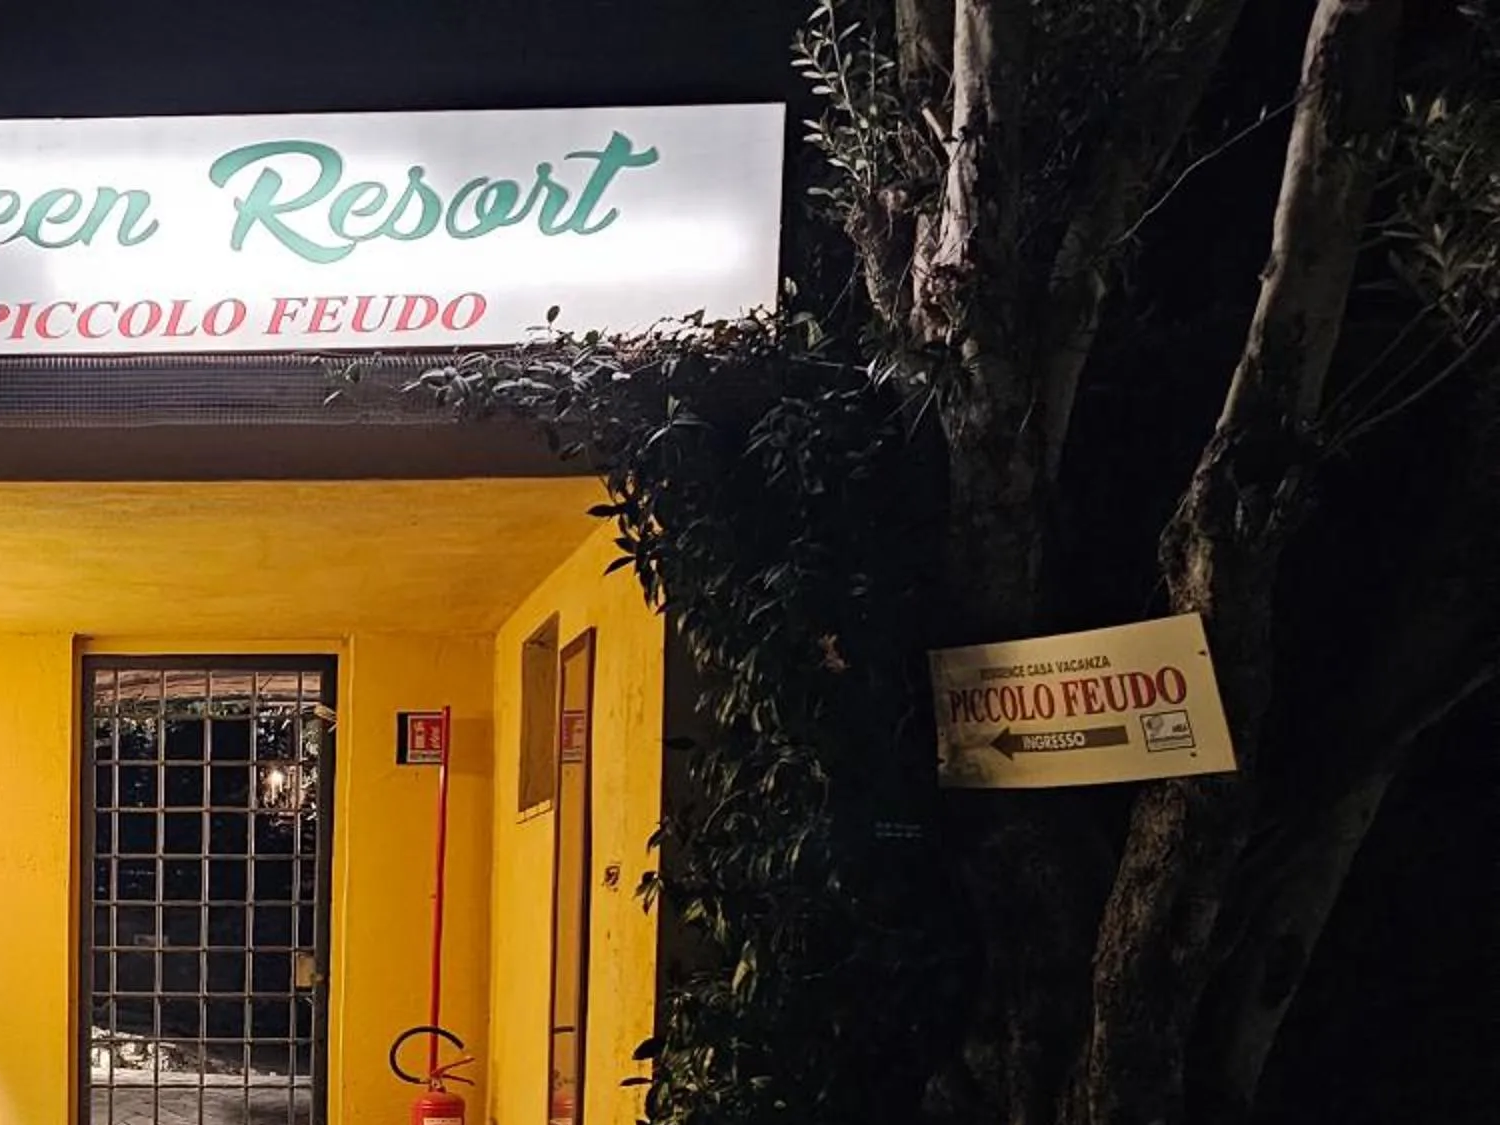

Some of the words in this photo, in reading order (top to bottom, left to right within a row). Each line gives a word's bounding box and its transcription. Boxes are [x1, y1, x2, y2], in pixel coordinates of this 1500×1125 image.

[209, 131, 660, 264] Resort
[263, 292, 488, 335] FEUDO
[951, 683, 1055, 723] PICCOLO
[1061, 666, 1187, 717] FEUDO
[1023, 731, 1086, 750] INGRESSO
